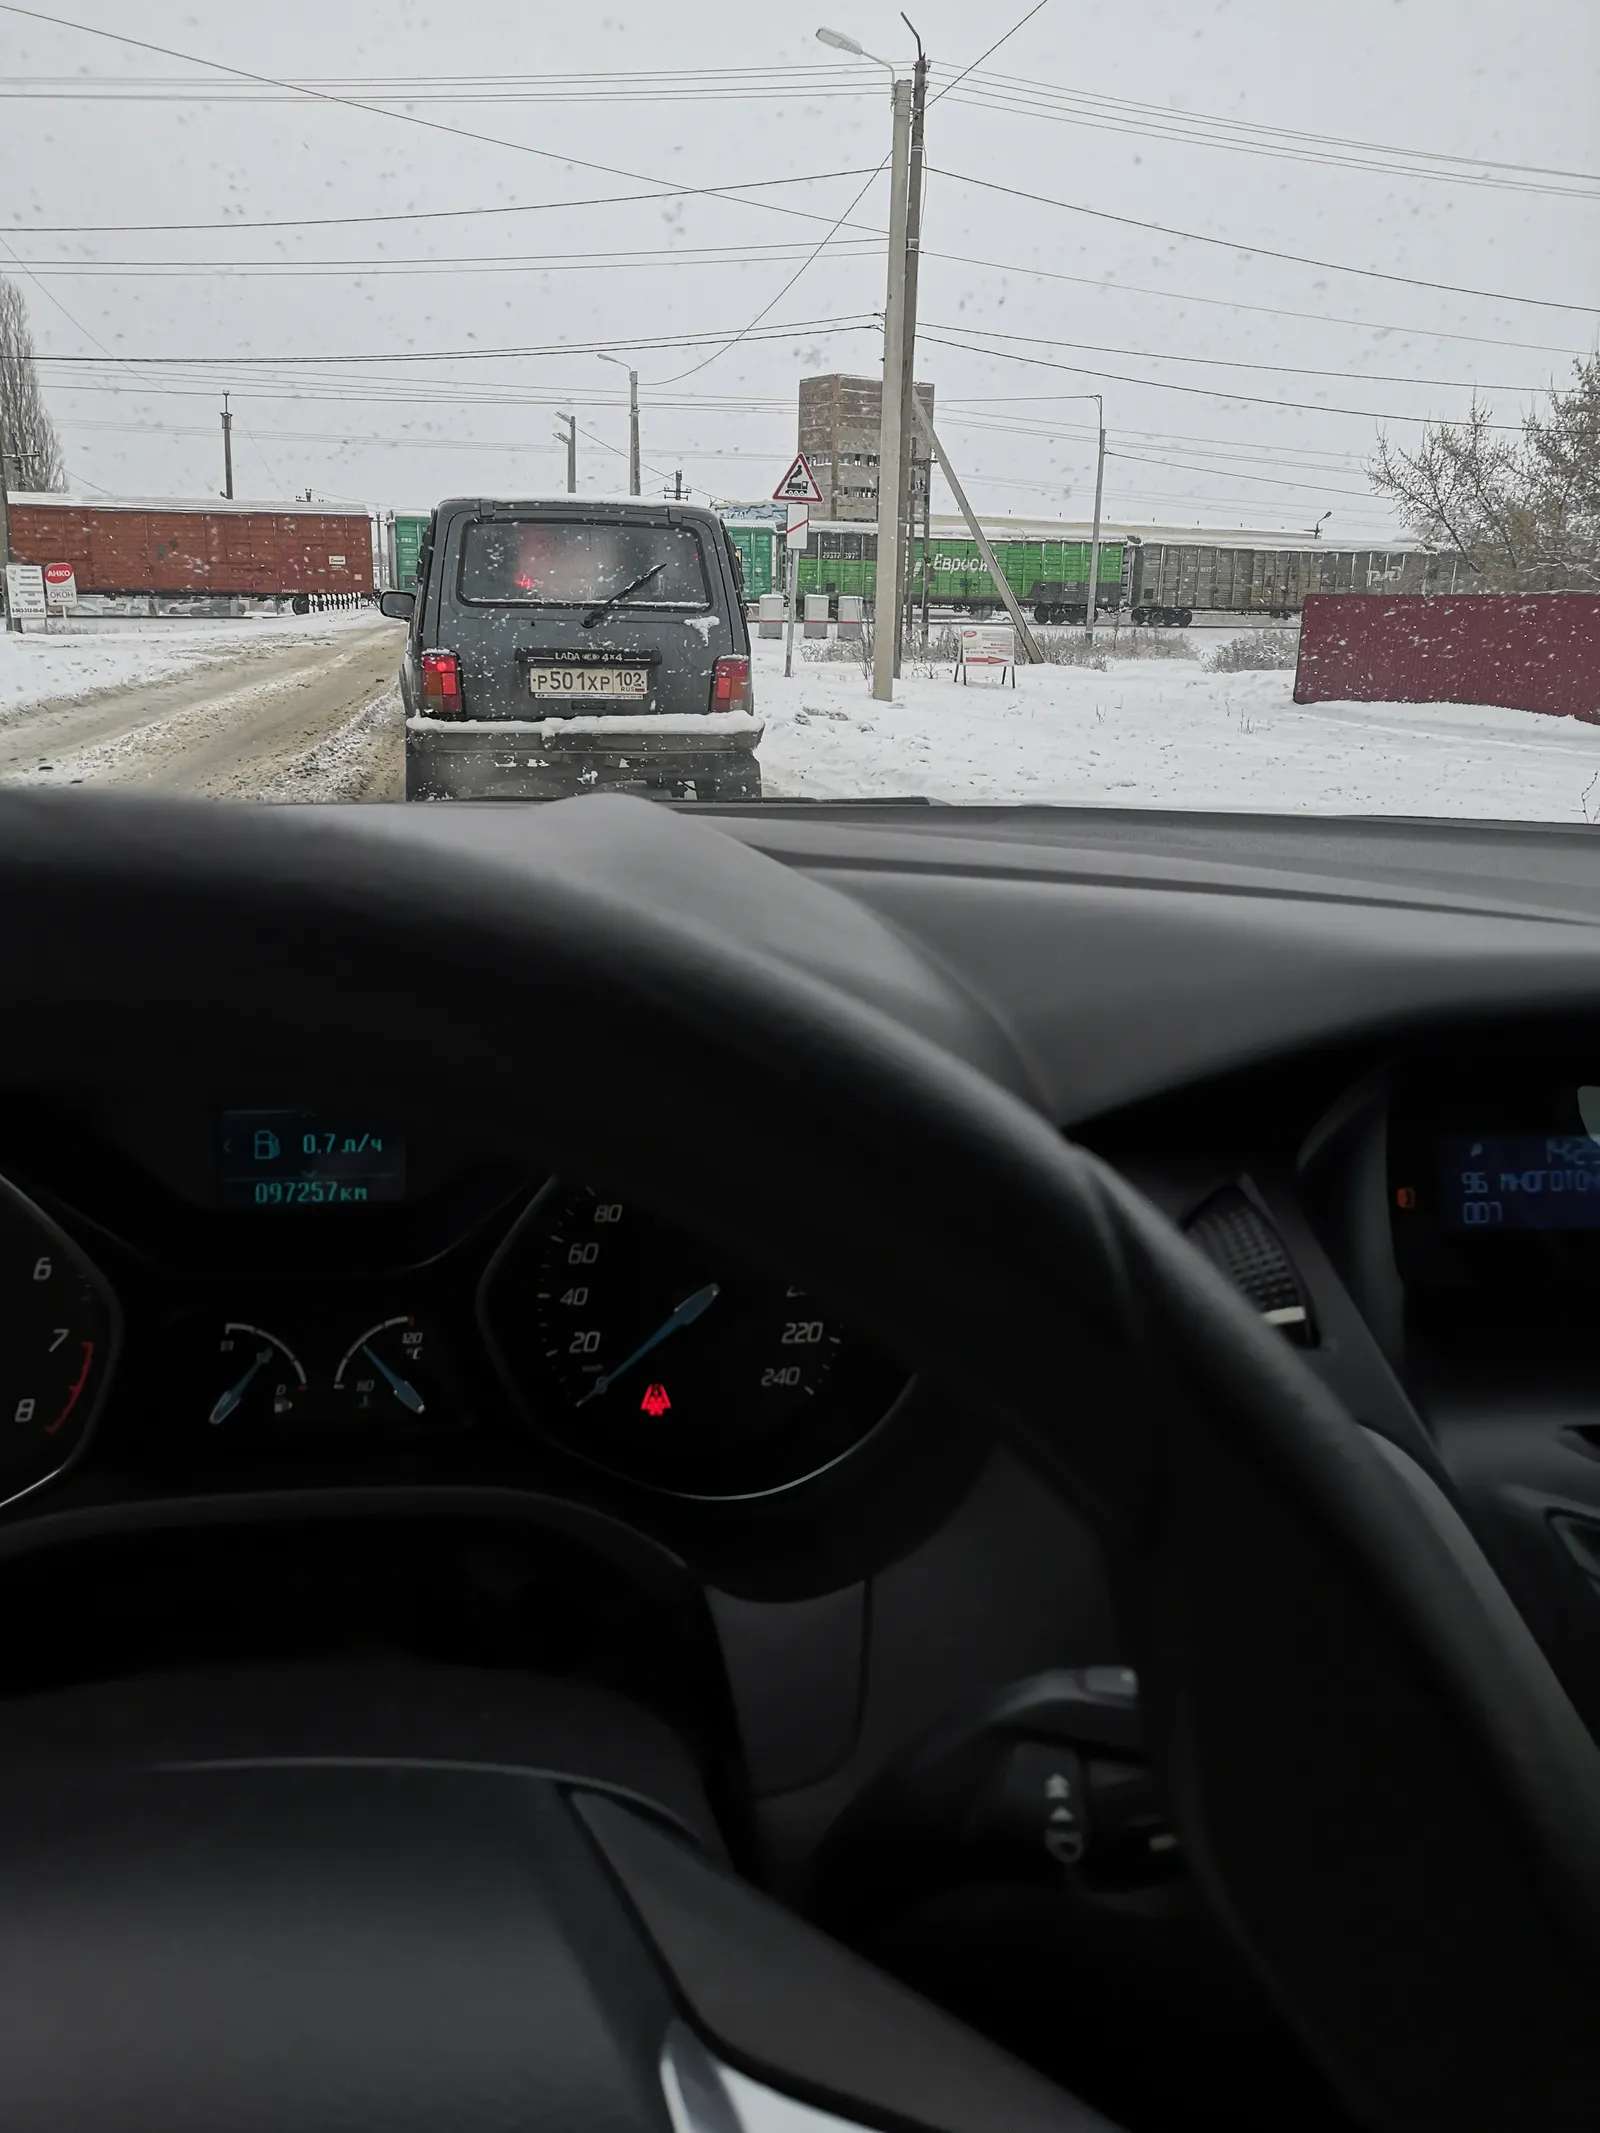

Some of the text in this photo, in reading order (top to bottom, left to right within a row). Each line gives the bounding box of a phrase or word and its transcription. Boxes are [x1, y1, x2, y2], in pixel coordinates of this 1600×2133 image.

[554, 652, 581, 661] LADA
[303, 1133, 337, 1155] 0.7
[594, 1204, 623, 1223] 80
[568, 1242, 599, 1264] 60
[33, 1256, 52, 1281] 6
[559, 1287, 589, 1306] 40
[48, 1327, 70, 1353] 7
[569, 1331, 601, 1354] 20
[780, 1321, 824, 1344] 220
[760, 1366, 801, 1388] 240
[14, 1398, 36, 1423] 8
